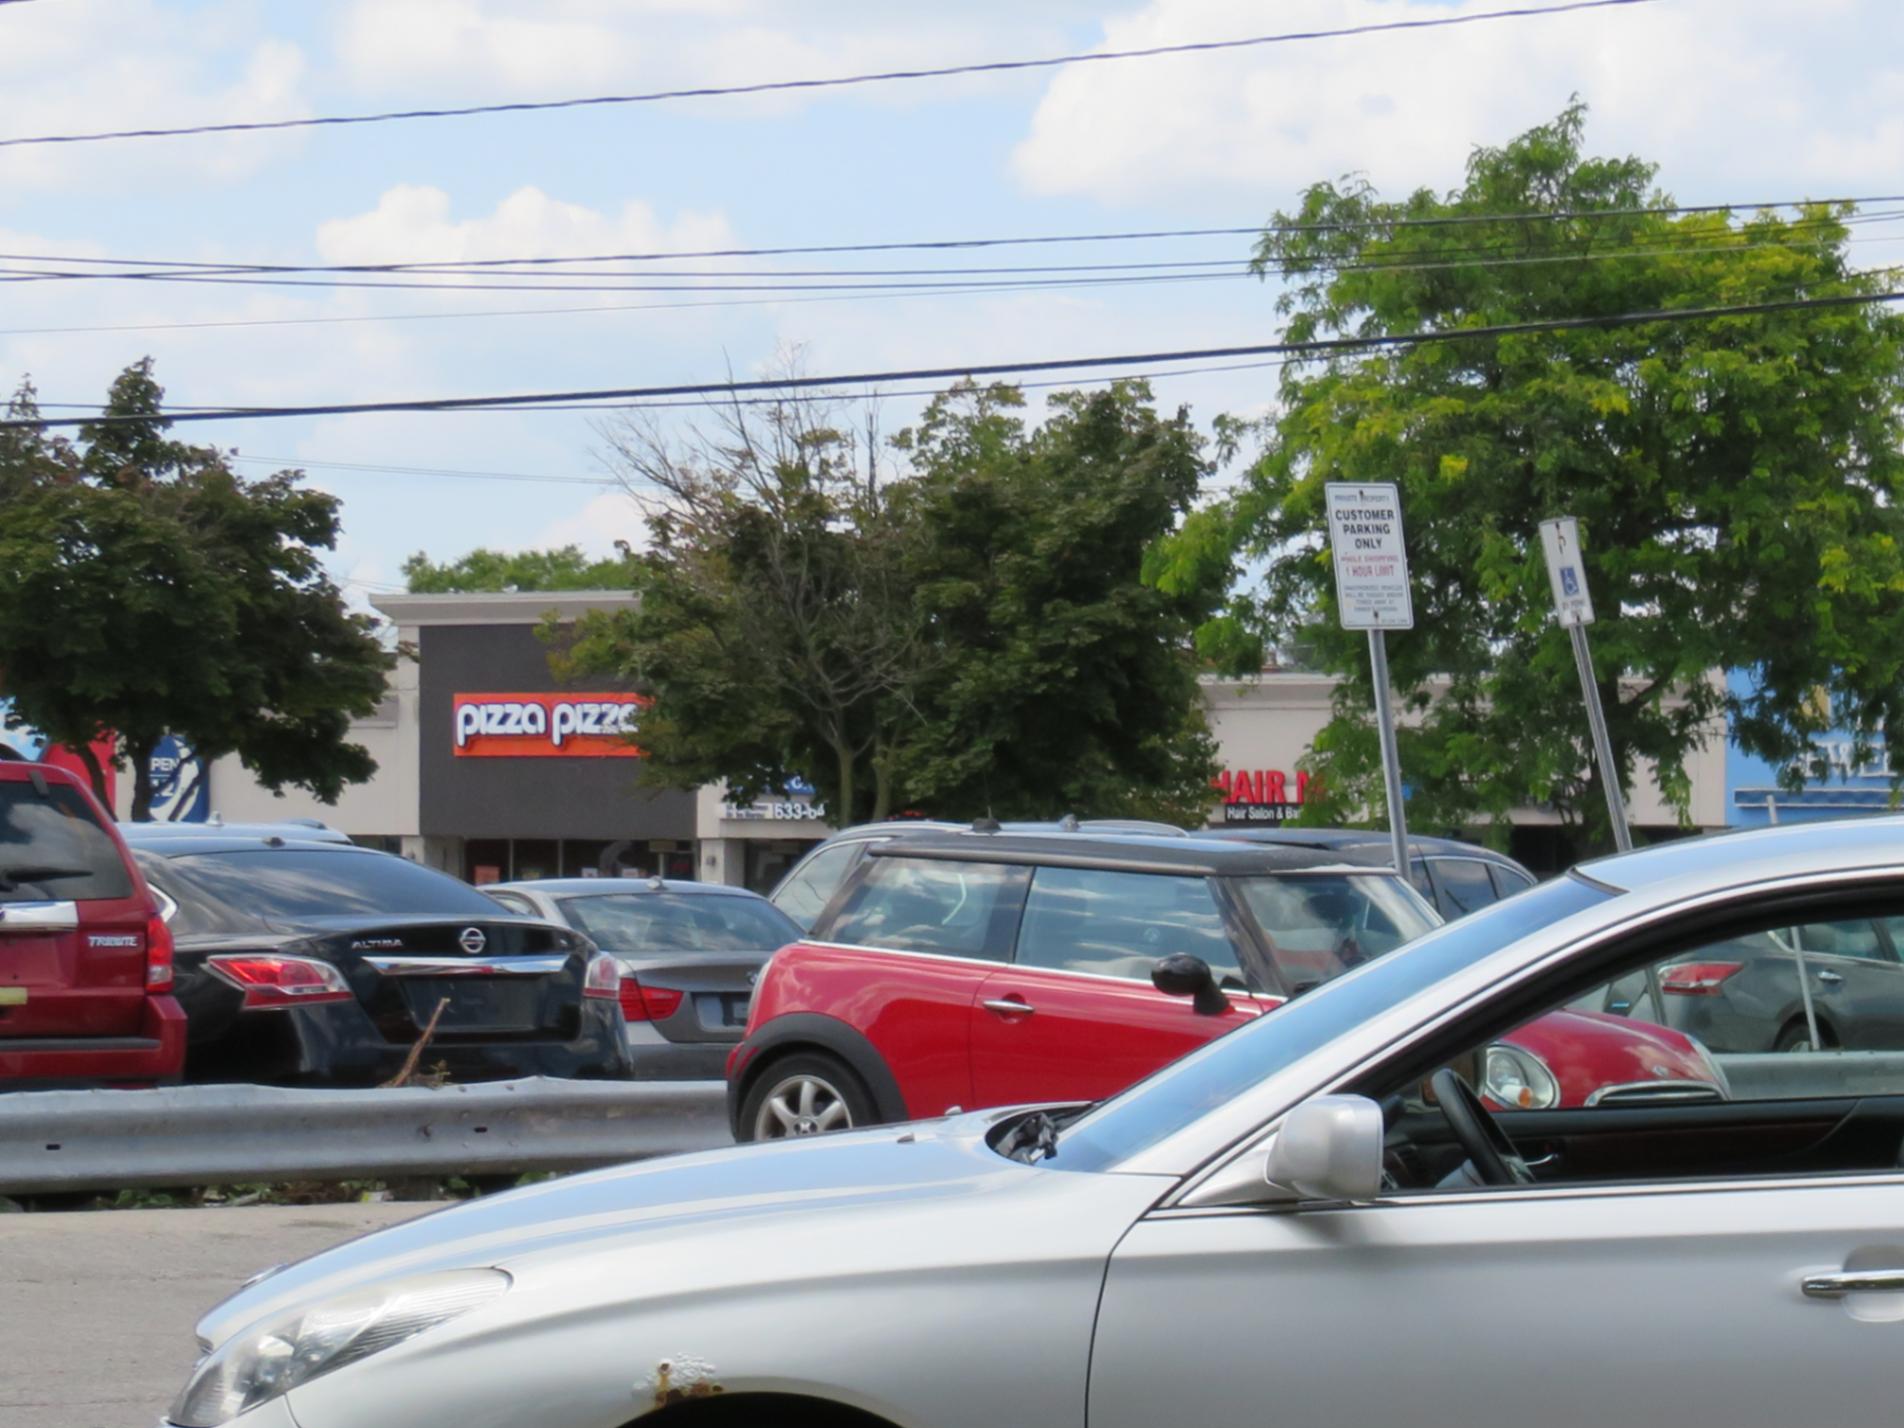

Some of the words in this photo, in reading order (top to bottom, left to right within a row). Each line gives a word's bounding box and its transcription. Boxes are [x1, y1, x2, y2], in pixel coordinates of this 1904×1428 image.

[1335, 509, 1395, 521] CUSTOMER
[1343, 523, 1391, 535] PARKING
[1354, 538, 1383, 550] ONLY
[456, 703, 547, 748] pizza
[1227, 806, 1246, 820] Hair
[1248, 806, 1275, 820] Salon
[351, 938, 404, 950] ALTIMA
